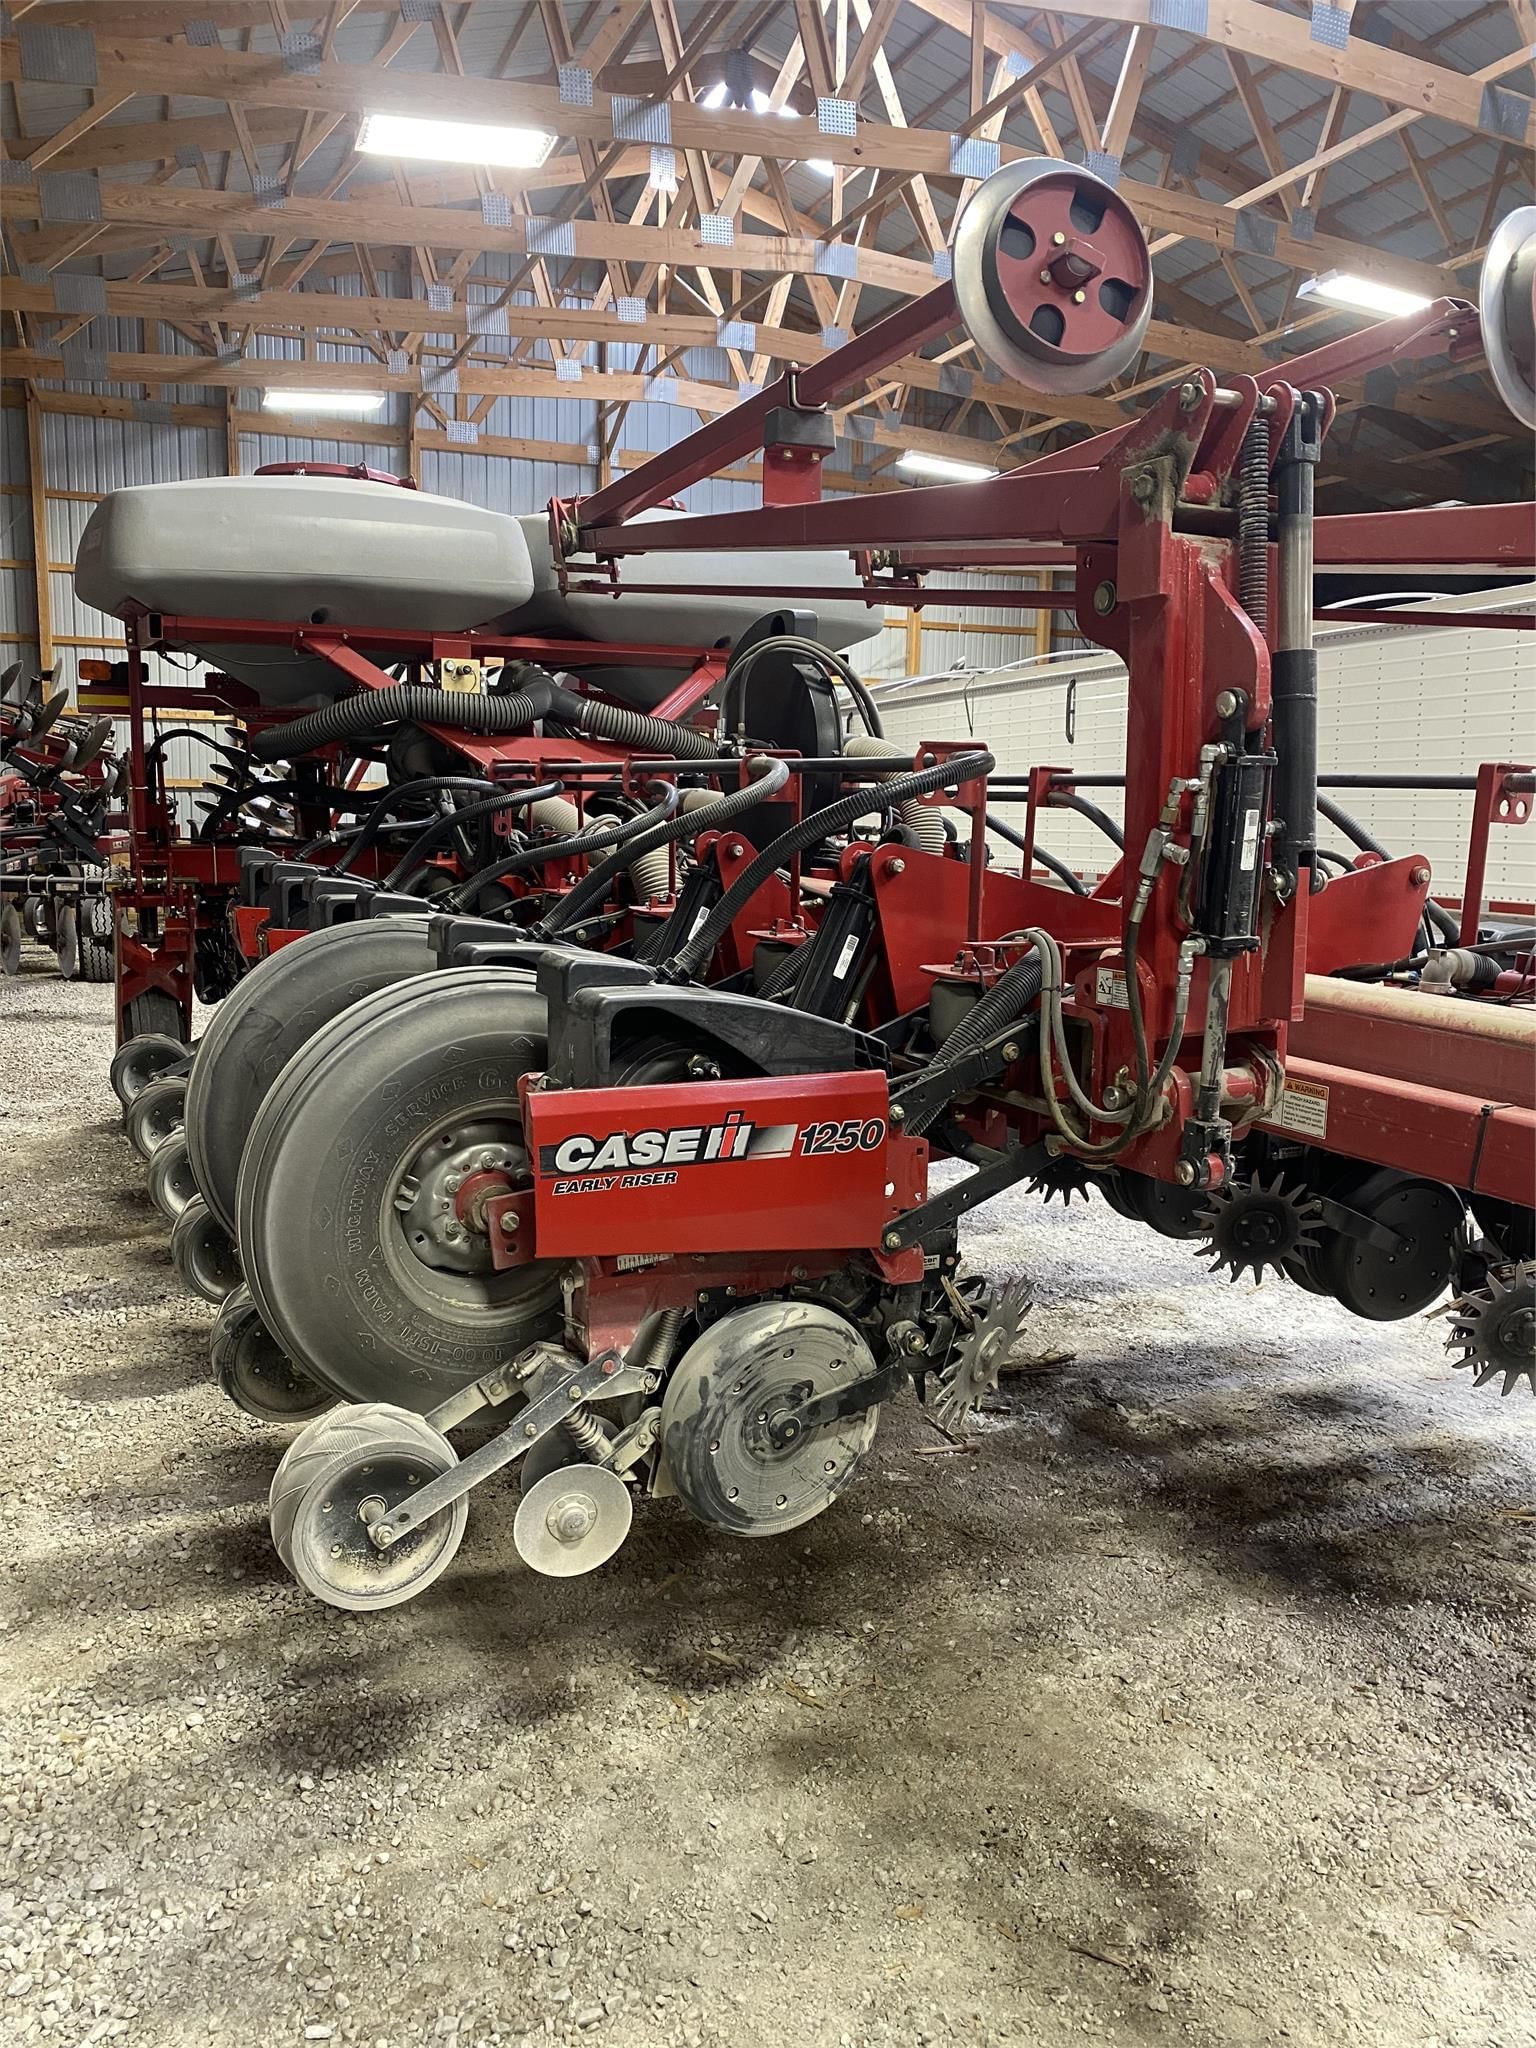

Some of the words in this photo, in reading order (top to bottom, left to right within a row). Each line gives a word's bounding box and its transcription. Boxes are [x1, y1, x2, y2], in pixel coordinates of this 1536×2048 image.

[385, 1076, 467, 1137] SERVICE
[1294, 1083, 1325, 1097] WARNING
[555, 1129, 702, 1173] CASE
[799, 1117, 886, 1156] 1250
[345, 1150, 380, 1254] HIGHWAY
[552, 1176, 618, 1196] EARLY
[620, 1171, 678, 1188] RISER
[354, 1268, 394, 1324] FARM
